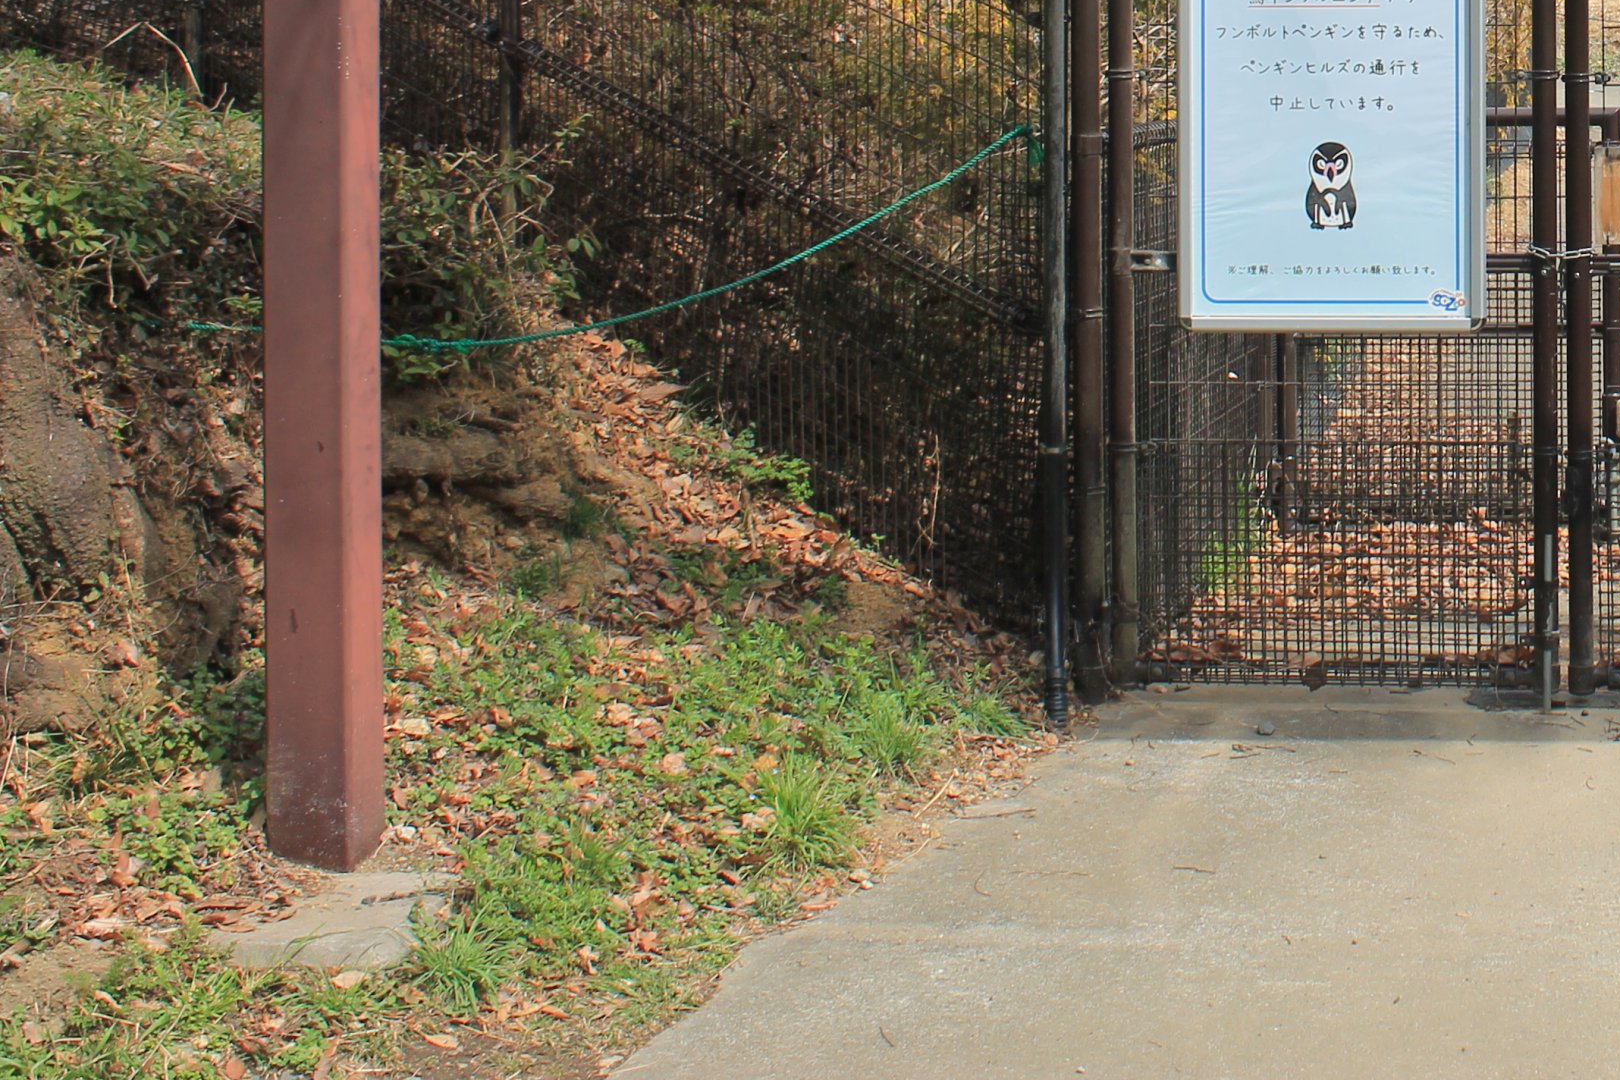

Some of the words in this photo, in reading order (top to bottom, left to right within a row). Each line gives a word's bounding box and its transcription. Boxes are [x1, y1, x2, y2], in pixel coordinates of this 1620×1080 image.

[1215, 23, 1445, 41] フンボルトペンギンを守るため、
[1240, 59, 1420, 76] ペンギンヒルズの通行を
[1269, 94, 1395, 111] 中止しています。
